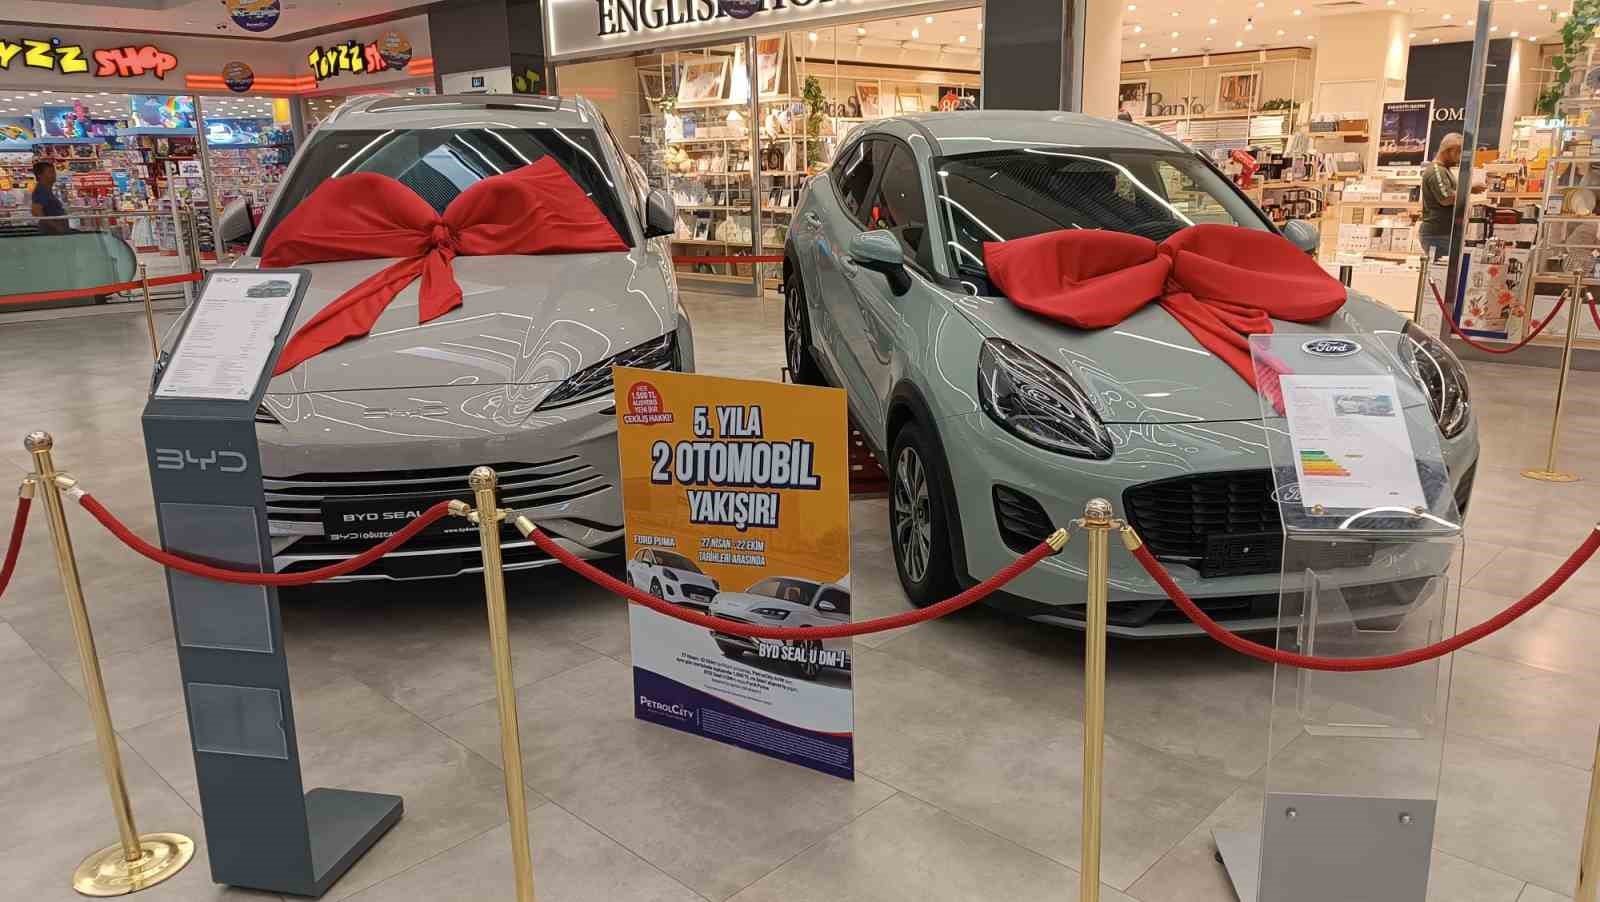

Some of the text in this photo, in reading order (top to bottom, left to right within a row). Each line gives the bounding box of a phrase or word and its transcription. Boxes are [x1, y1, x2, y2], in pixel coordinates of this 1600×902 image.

[94, 45, 177, 79] SHOP
[1311, 341, 1348, 353] Ford
[693, 406, 762, 438] 5. YILA
[156, 448, 248, 472] BYD
[652, 439, 820, 488] 2 OTOMOBİL
[343, 512, 379, 522] BYD
[687, 491, 779, 530] YAKIŞIR!
[633, 535, 675, 547] FORD PUMA
[747, 540, 765, 551] EKİM
[731, 553, 766, 566] ARASINDA
[759, 643, 779, 658] BYD
[781, 646, 807, 662] SEAL
[809, 649, 817, 664] U
